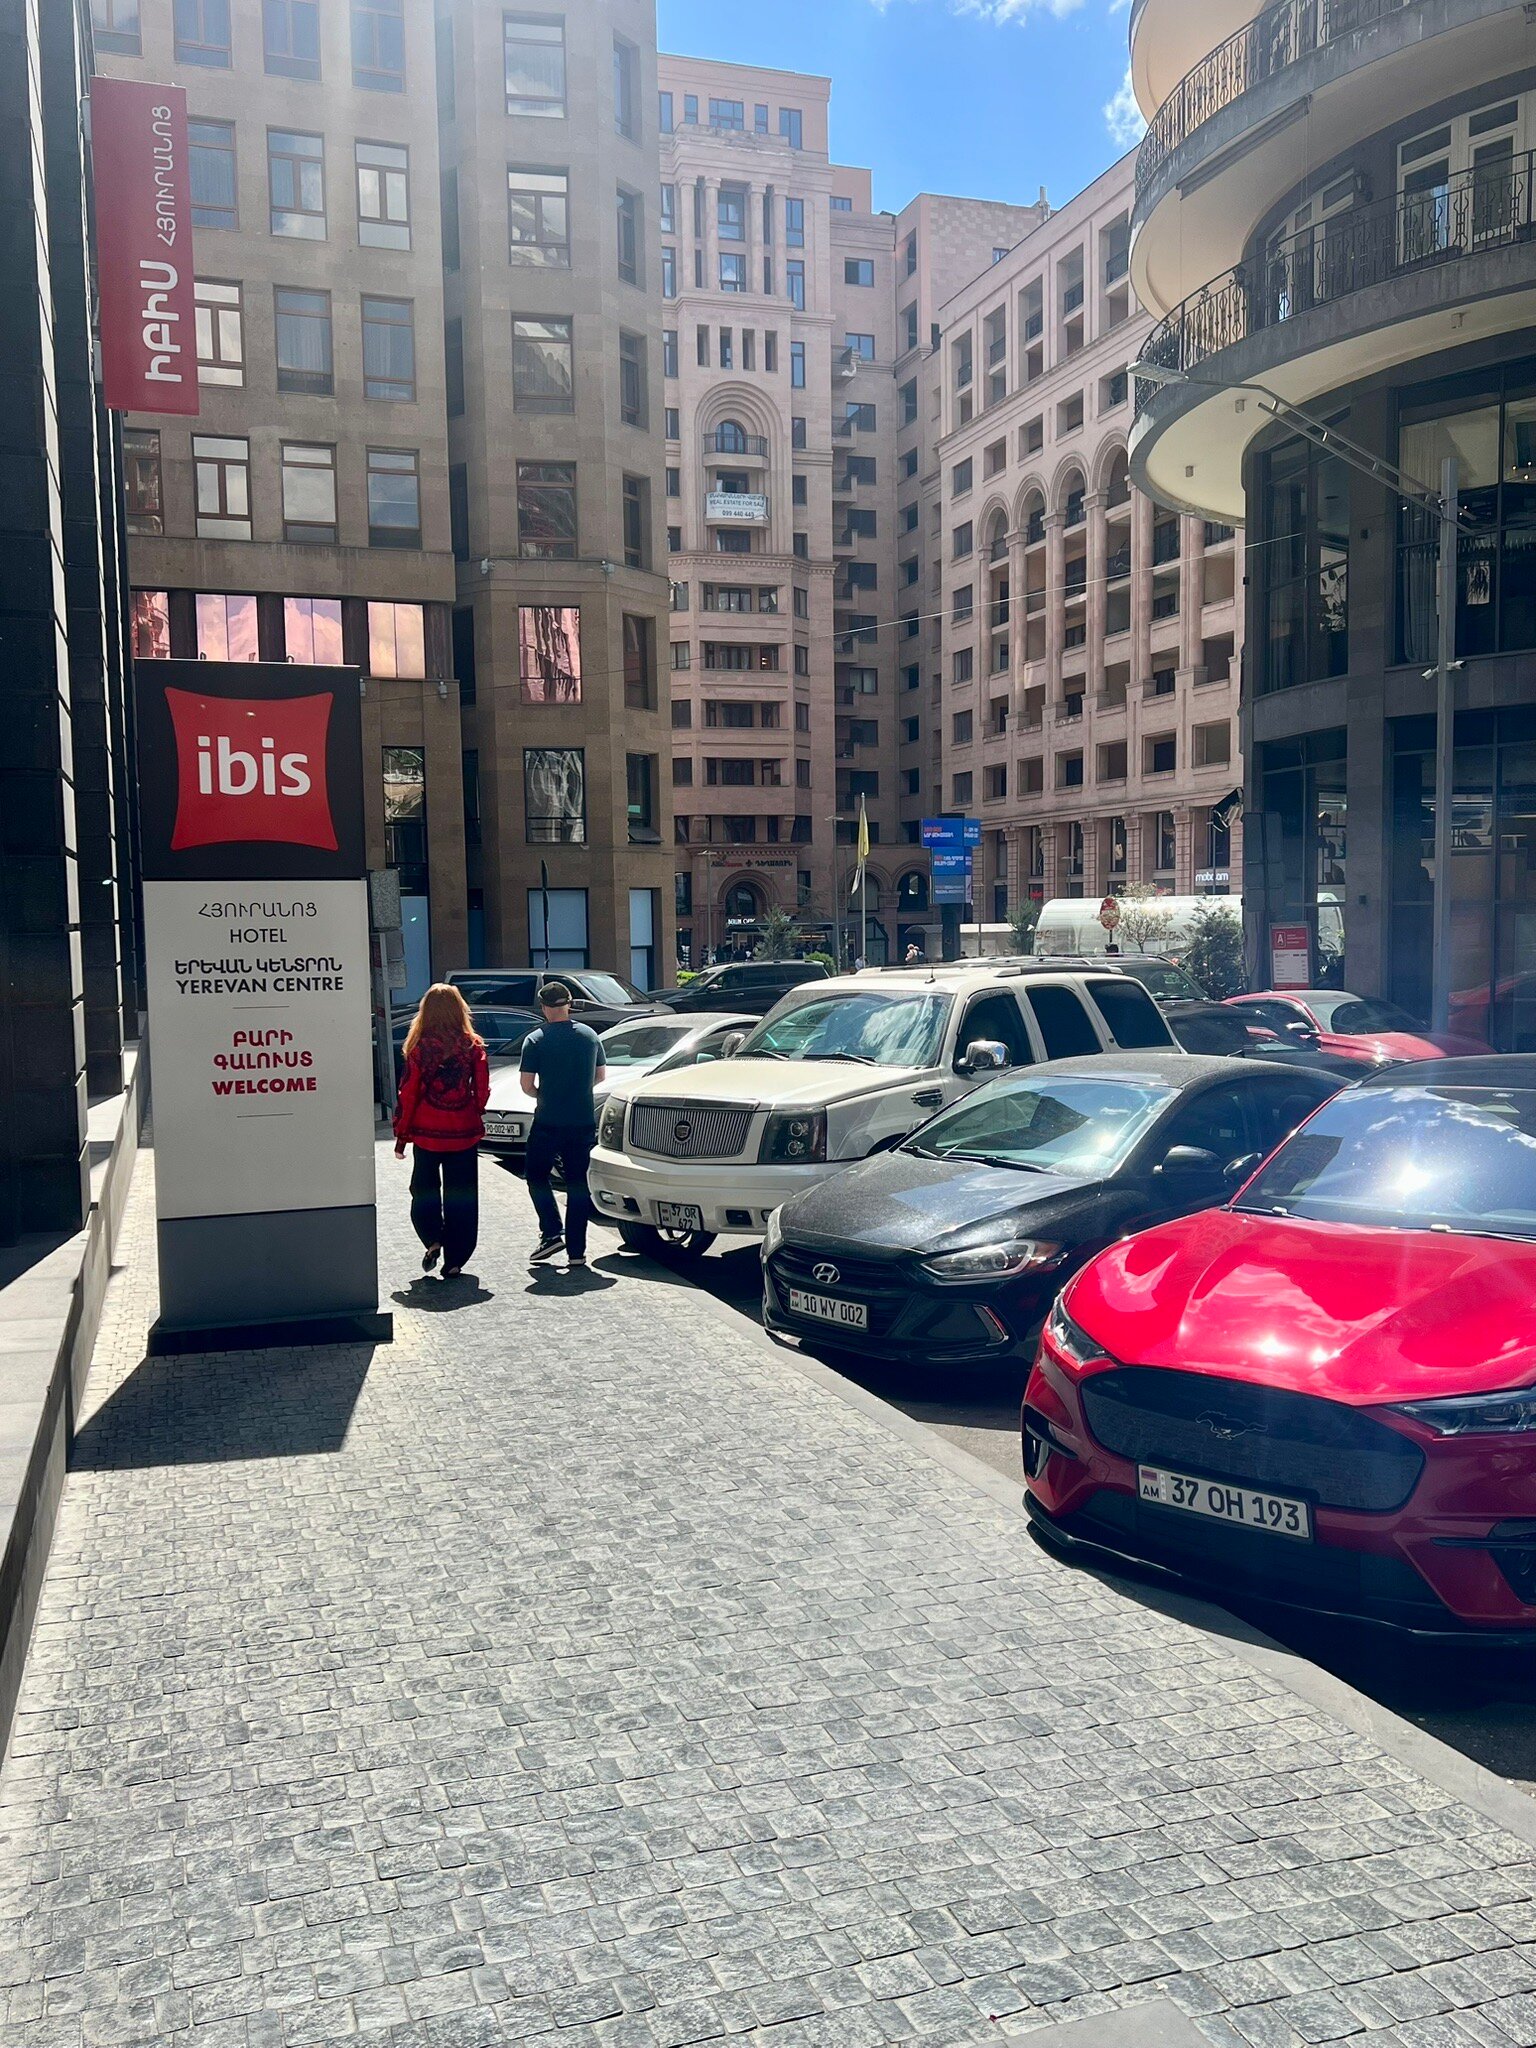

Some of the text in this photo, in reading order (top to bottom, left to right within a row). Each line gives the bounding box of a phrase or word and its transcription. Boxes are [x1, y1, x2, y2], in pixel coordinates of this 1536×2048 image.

[139, 105, 182, 382] ԻԲԻՍ ՀՅՈՒՐԱՆՈՑ
[198, 736, 311, 797] ibis
[198, 902, 318, 918] ՀՅՈՒՐԱՆՈՑ
[229, 928, 288, 943] HOTEL
[174, 957, 343, 974] ԵՐԵՎԱՆ ԿԵՆՏՐՈՆ
[175, 976, 344, 994] YEREVAN CENTRE
[232, 1029, 293, 1047] ԲԱՐԻ
[213, 1051, 313, 1070] ԳԱԼՈՒՍՏ
[211, 1077, 317, 1096] WELCOME
[684, 1207, 697, 1220] OR
[803, 1294, 817, 1313] 10
[819, 1298, 836, 1318] WY
[840, 1303, 863, 1325] 002
[1142, 1476, 1300, 1531] AM 37 OH 193
